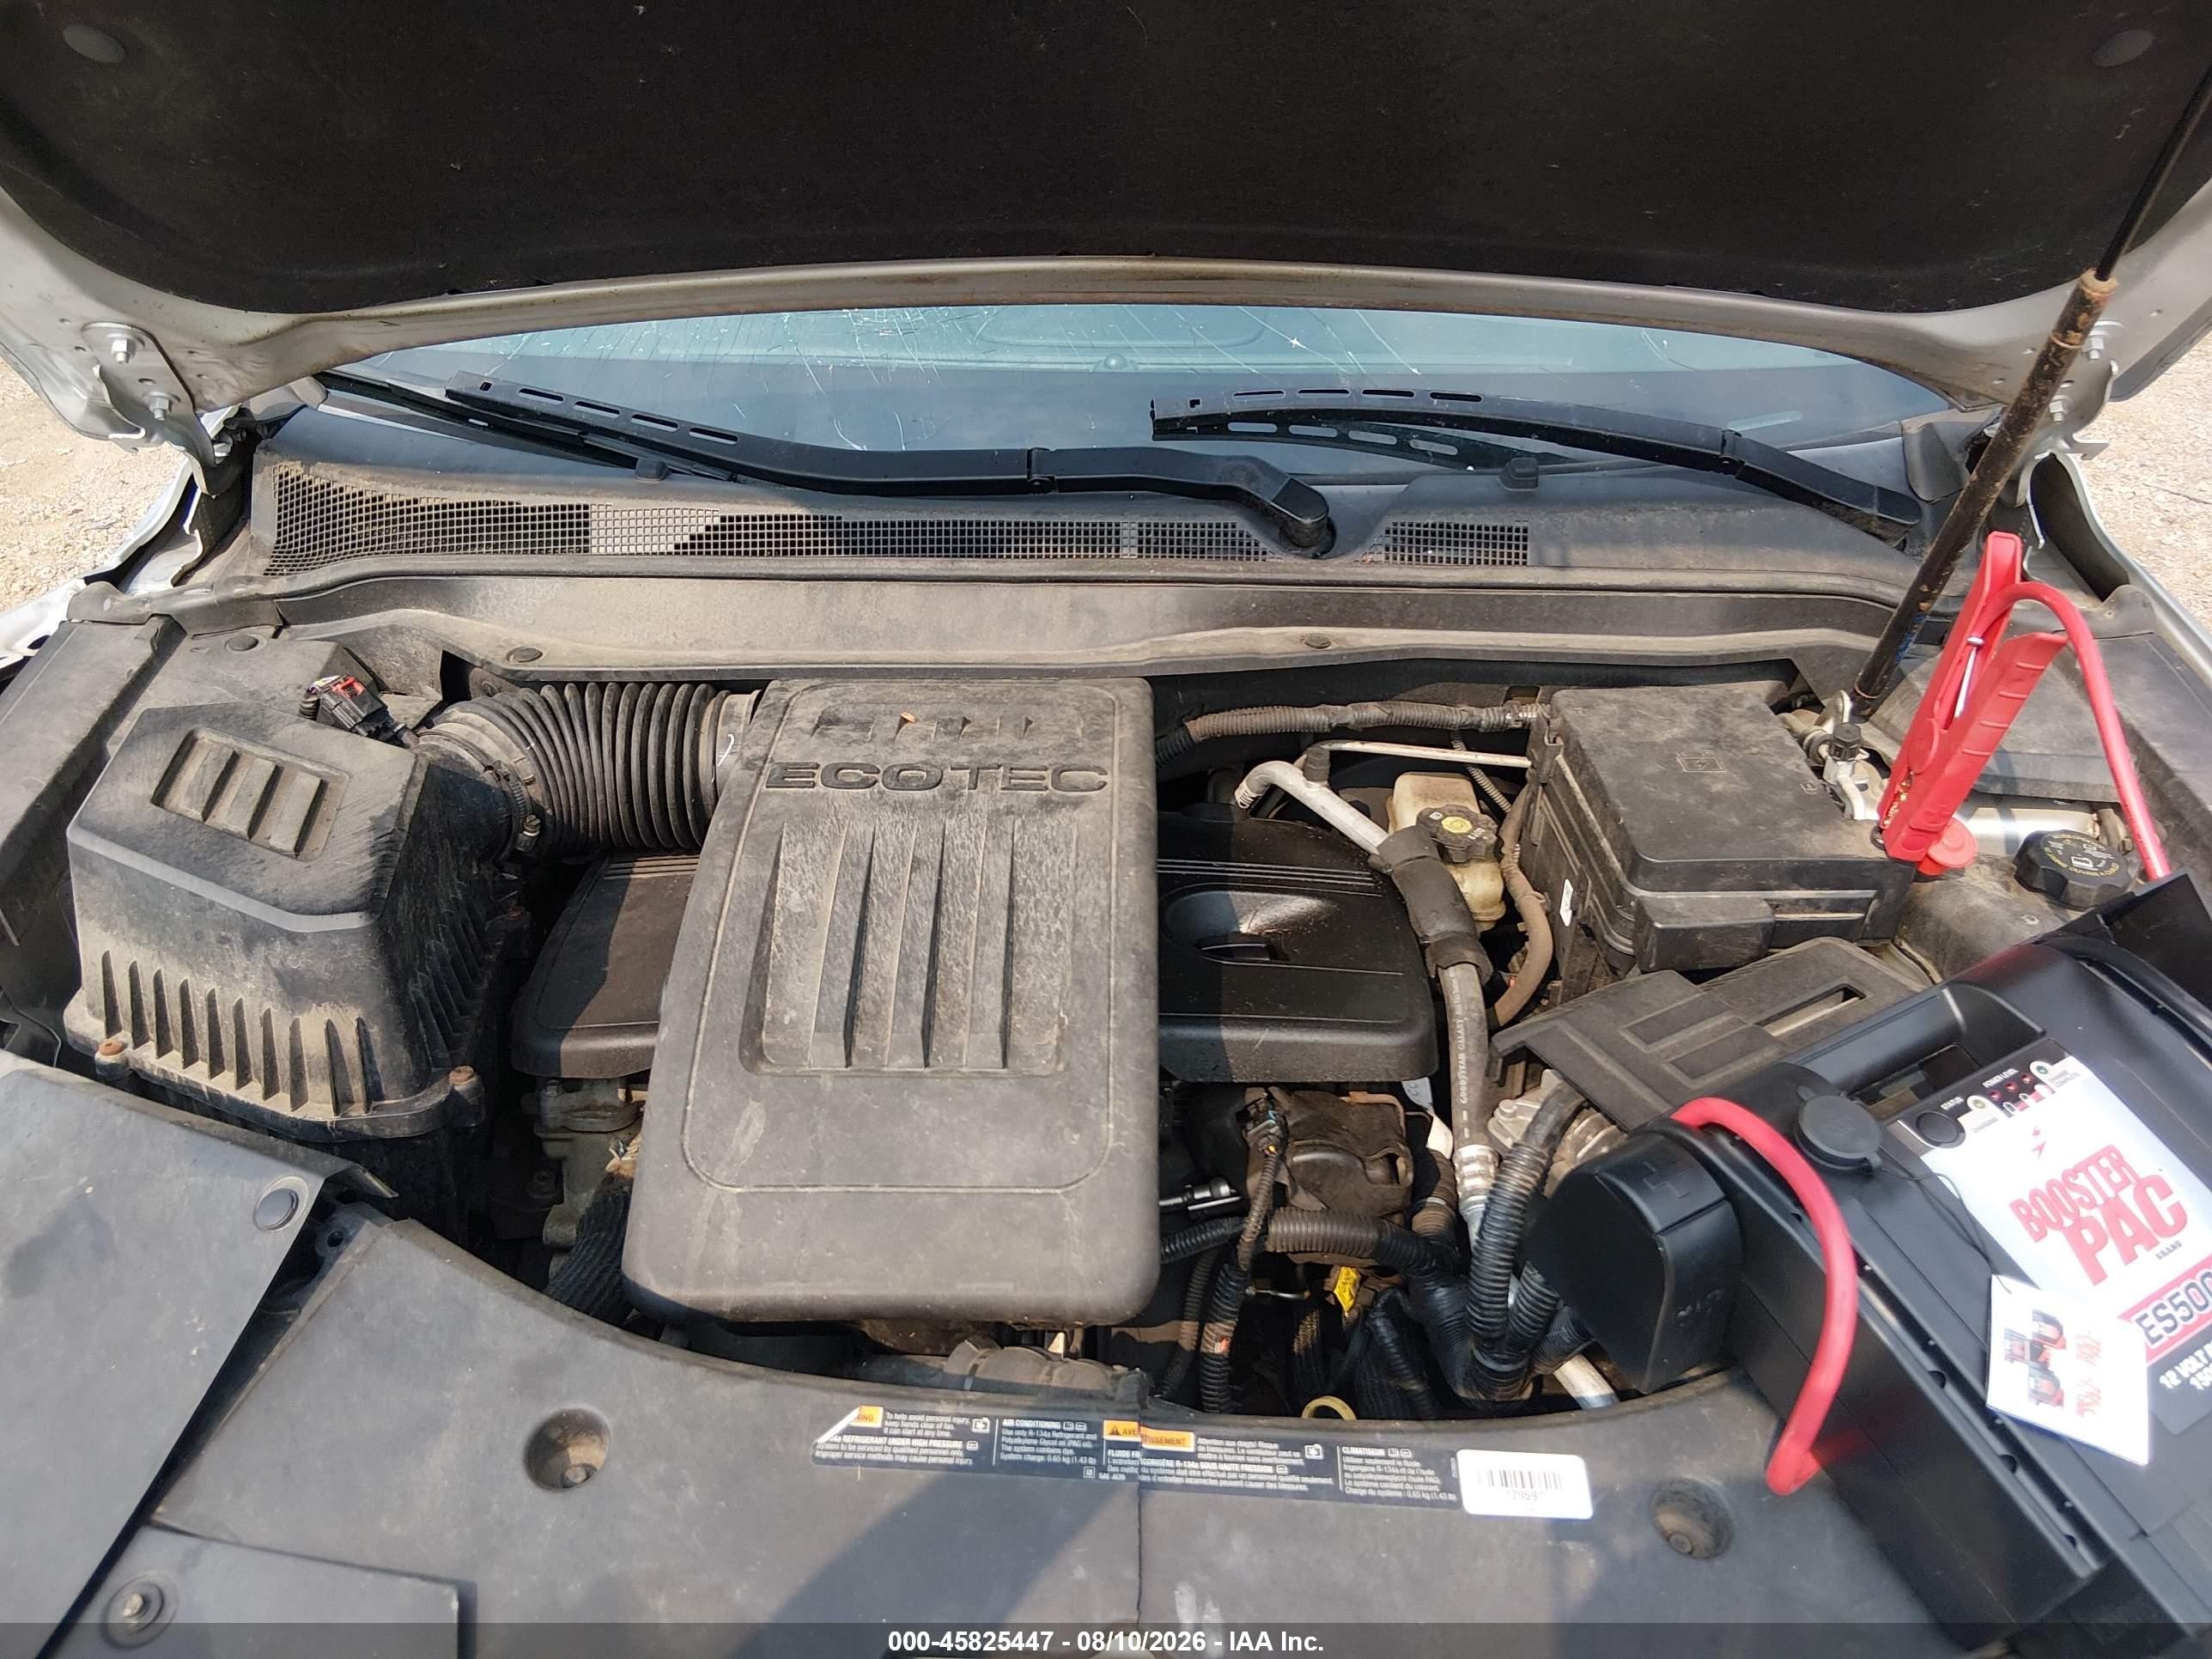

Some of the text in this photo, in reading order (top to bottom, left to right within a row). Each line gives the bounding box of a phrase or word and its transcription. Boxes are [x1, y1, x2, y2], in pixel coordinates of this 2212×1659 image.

[764, 762, 1108, 793] ECOTEC
[1458, 1053, 1468, 1104] GOODYEAR
[2009, 1144, 2140, 1243] BOOSTER
[2061, 1174, 2188, 1286] PAC
[2159, 1370, 2182, 1389] 12
[2173, 1349, 2209, 1378] VOLT
[926, 1413, 951, 1424] personal
[1001, 1419, 1061, 1429] AIR CONDITIONING
[1001, 1427, 1013, 1436] Use
[1014, 1428, 1027, 1437] only
[842, 1436, 888, 1446] REFRIGERANT
[888, 1437, 909, 1447] UNDER
[911, 1438, 928, 1447] HIGH
[929, 1438, 963, 1449] PRESSURE
[1039, 1438, 1058, 1448] Glycol
[1013, 1445, 1035, 1455] system
[1036, 1446, 1061, 1455] contains
[1108, 1449, 1128, 1459] FLUIDE
[1341, 1446, 1386, 1457] CLIMATISEUR
[1000, 1453, 1023, 1462] System
[1200, 1461, 1218, 1470] SOUS
[1218, 1462, 1240, 1472] HAUTE
[1240, 1463, 1273, 1474] PRESSION
